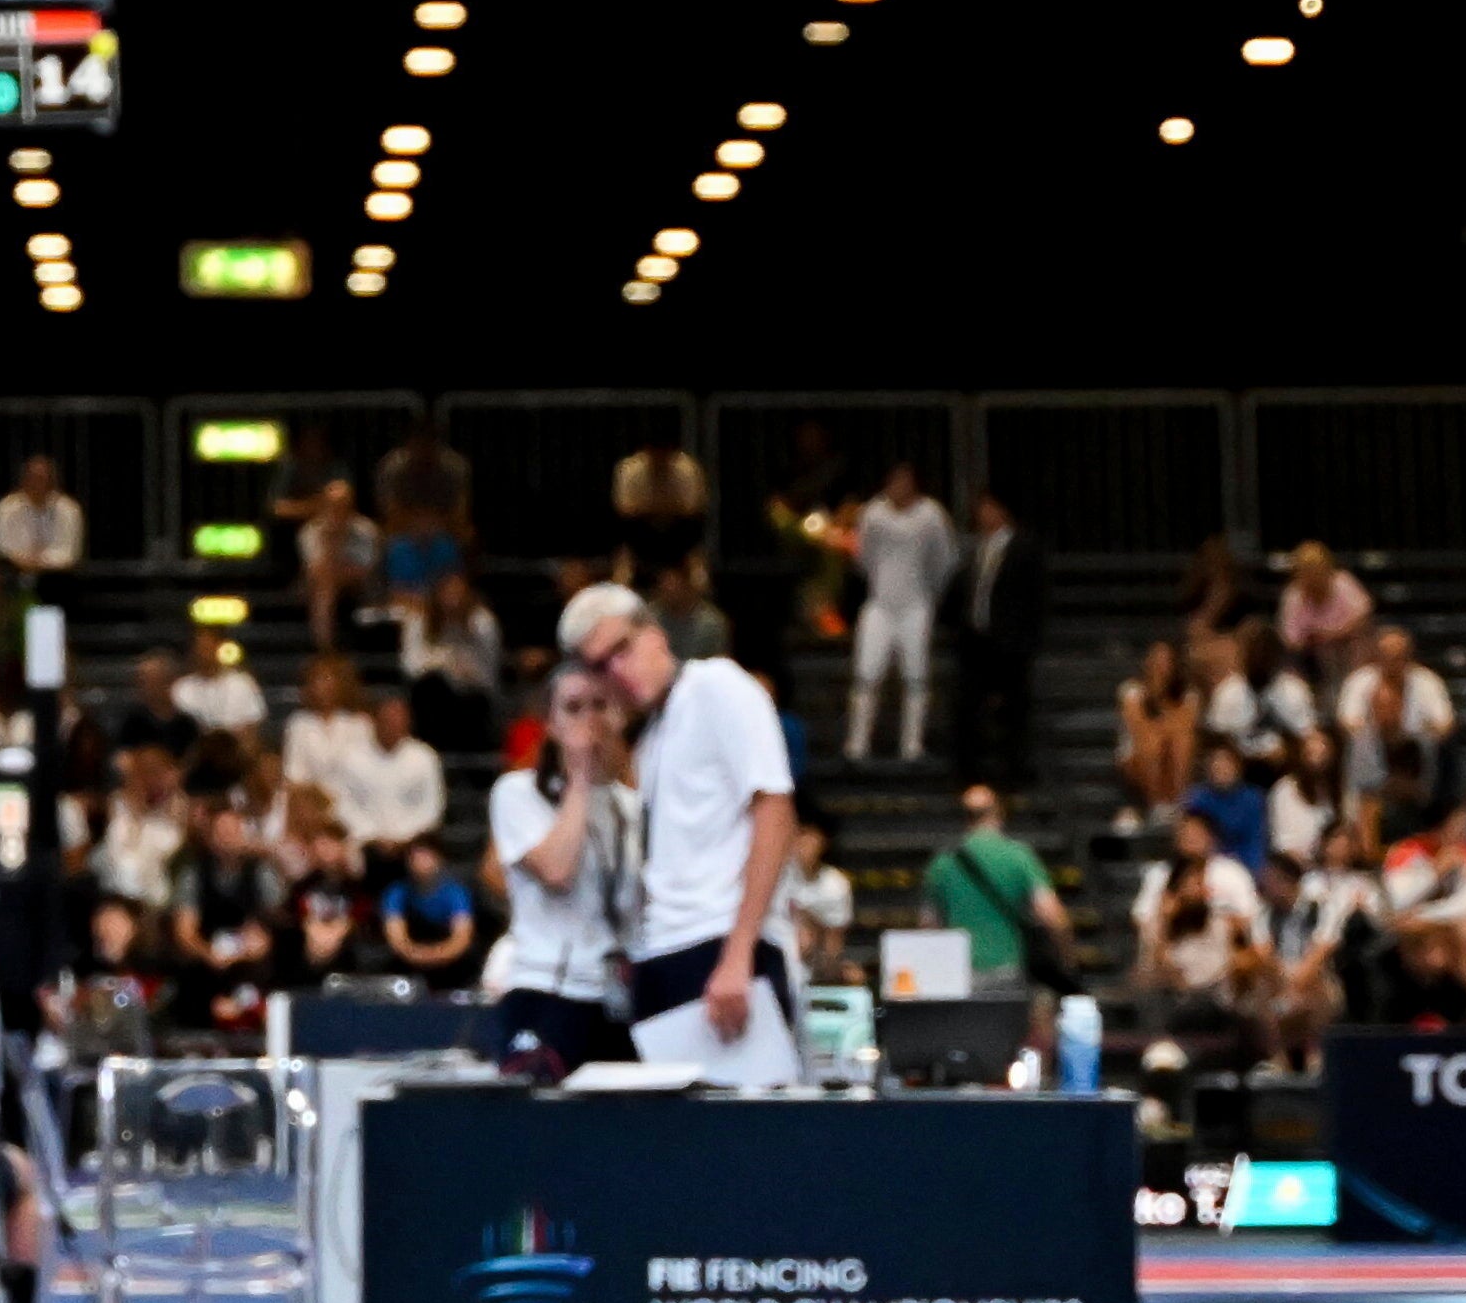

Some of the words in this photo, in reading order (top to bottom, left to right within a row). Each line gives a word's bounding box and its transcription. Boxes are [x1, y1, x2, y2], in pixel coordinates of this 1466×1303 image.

[34, 55, 113, 106] 14
[647, 1258, 702, 1292] FIE
[704, 1258, 868, 1293] FENCING
